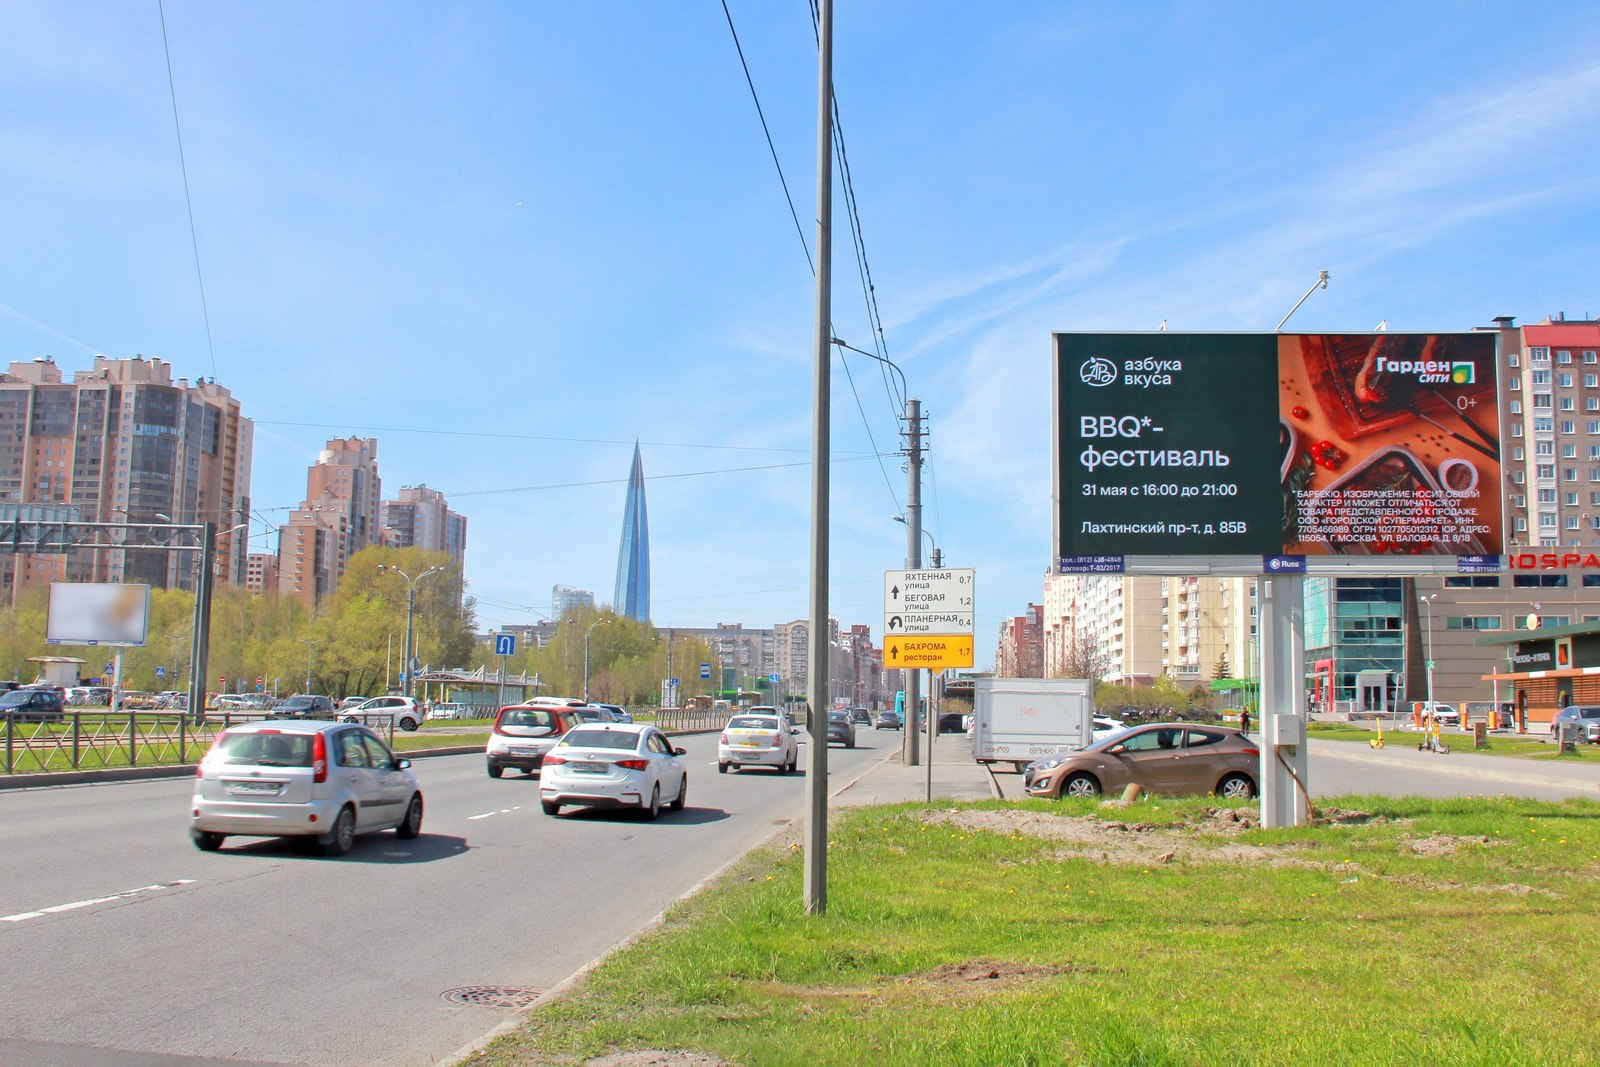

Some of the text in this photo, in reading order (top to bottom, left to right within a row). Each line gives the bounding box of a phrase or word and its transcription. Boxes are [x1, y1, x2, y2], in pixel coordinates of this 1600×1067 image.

[1124, 357, 1182, 374] азбука
[1376, 357, 1450, 374] Гарден
[1124, 374, 1172, 388] вкуса
[1456, 396, 1478, 410] 0+
[1080, 445, 1230, 472] фестиваль
[1082, 484, 1237, 498] 31 мая с 16:00 до 21:00
[1446, 489, 1480, 498] ОБЩИЙ
[1321, 516, 1381, 525] «ГОРОДСКОЙ
[1081, 521, 1247, 535] Лахтинский пр-т, д. 85В
[1452, 535, 1470, 543] 8/18
[959, 576, 971, 584] 0,7
